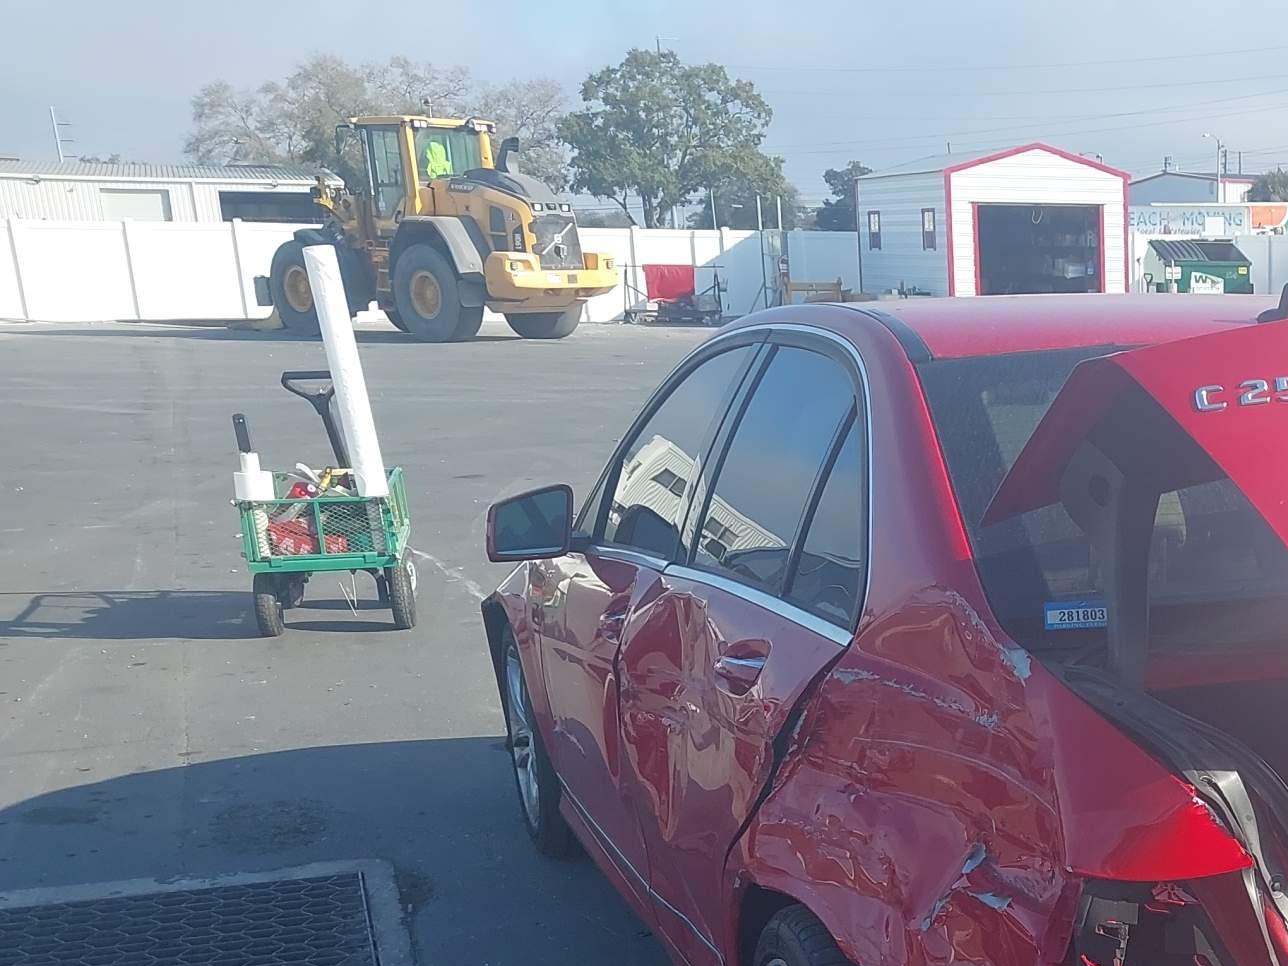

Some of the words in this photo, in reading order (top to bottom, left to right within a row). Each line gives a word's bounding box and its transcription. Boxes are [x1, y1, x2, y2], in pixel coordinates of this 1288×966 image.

[1182, 212, 1243, 226] MONG
[1194, 383, 1228, 412] C
[1058, 608, 1105, 622] 281803
